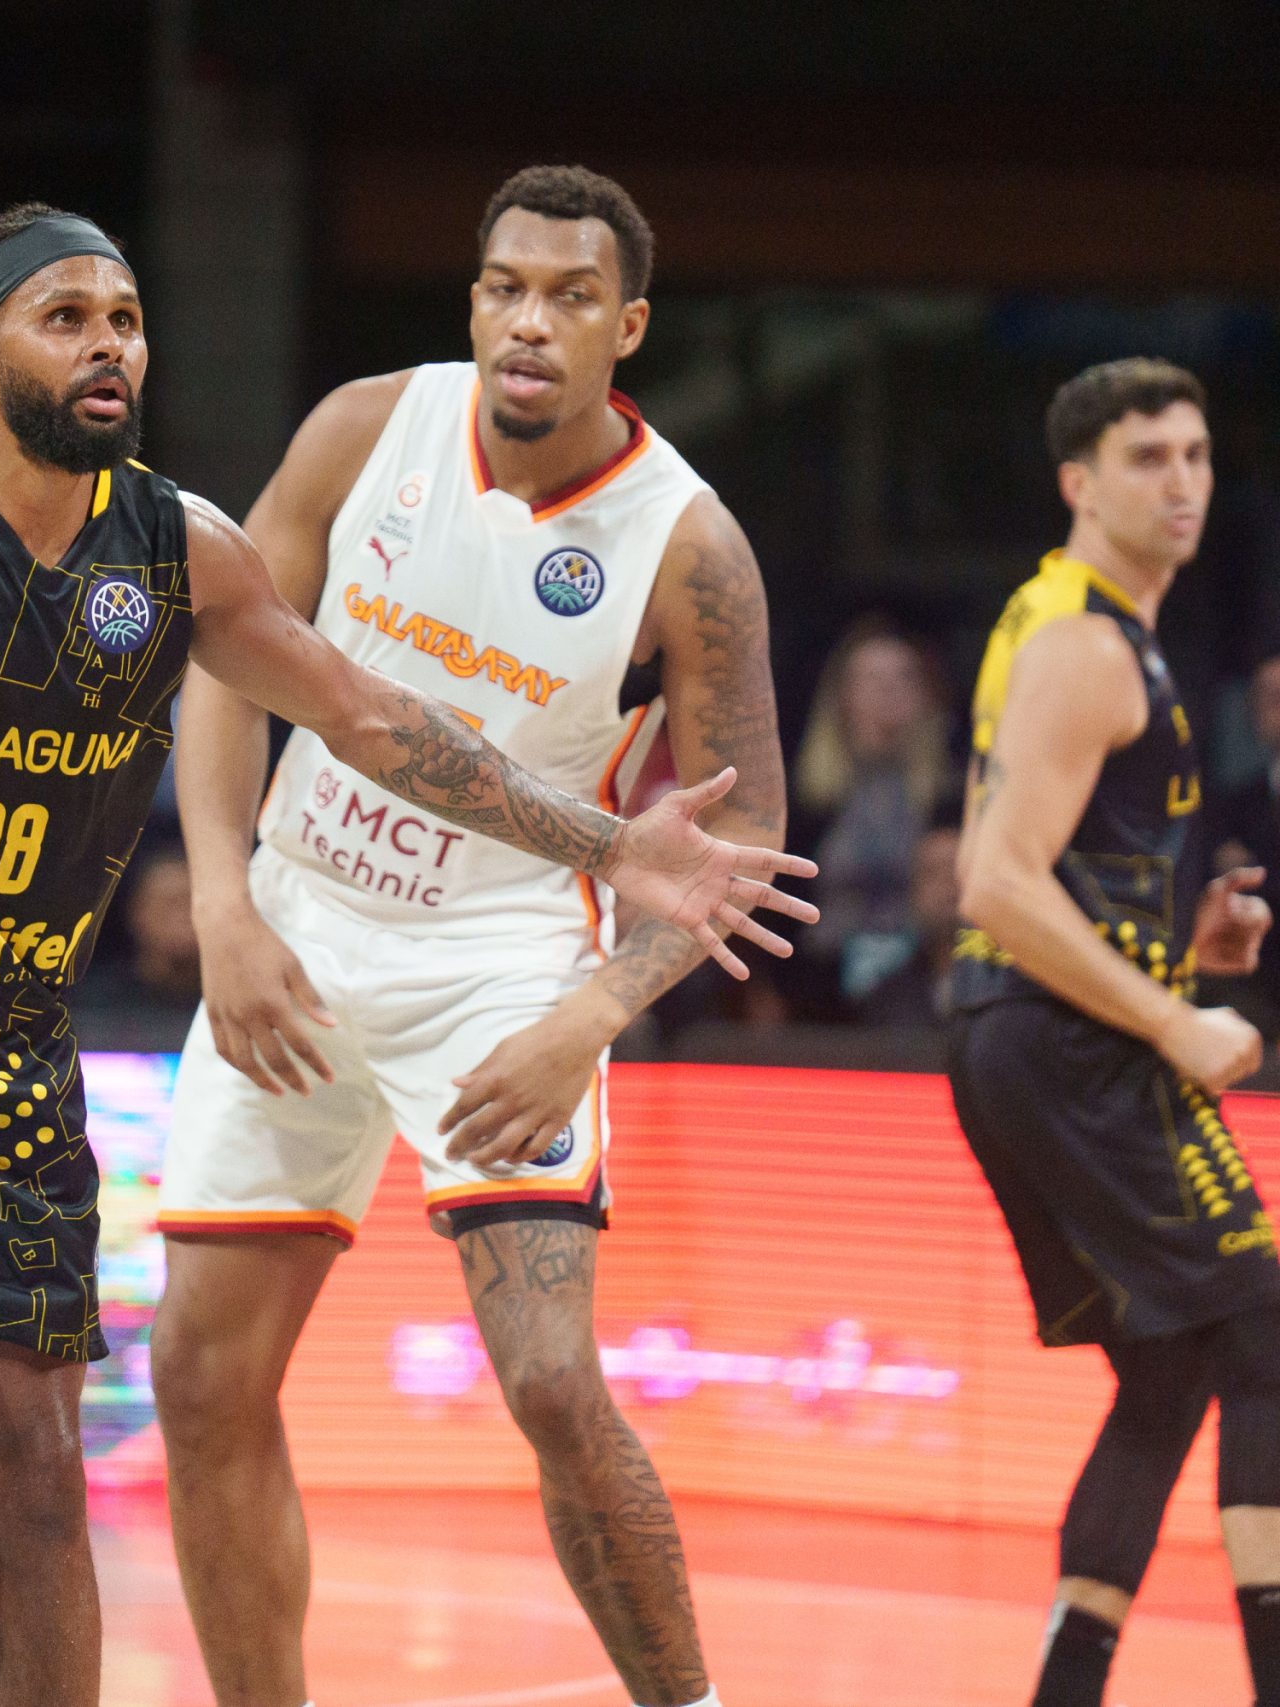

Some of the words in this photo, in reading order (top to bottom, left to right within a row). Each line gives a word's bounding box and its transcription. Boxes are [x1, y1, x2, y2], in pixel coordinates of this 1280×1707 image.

[91, 653, 104, 669] A
[343, 582, 570, 707] GALATASARAY
[82, 692, 102, 709] Hi
[341, 789, 465, 869] MCT
[302, 810, 443, 907] Technic
[21, 1248, 37, 1262] B
